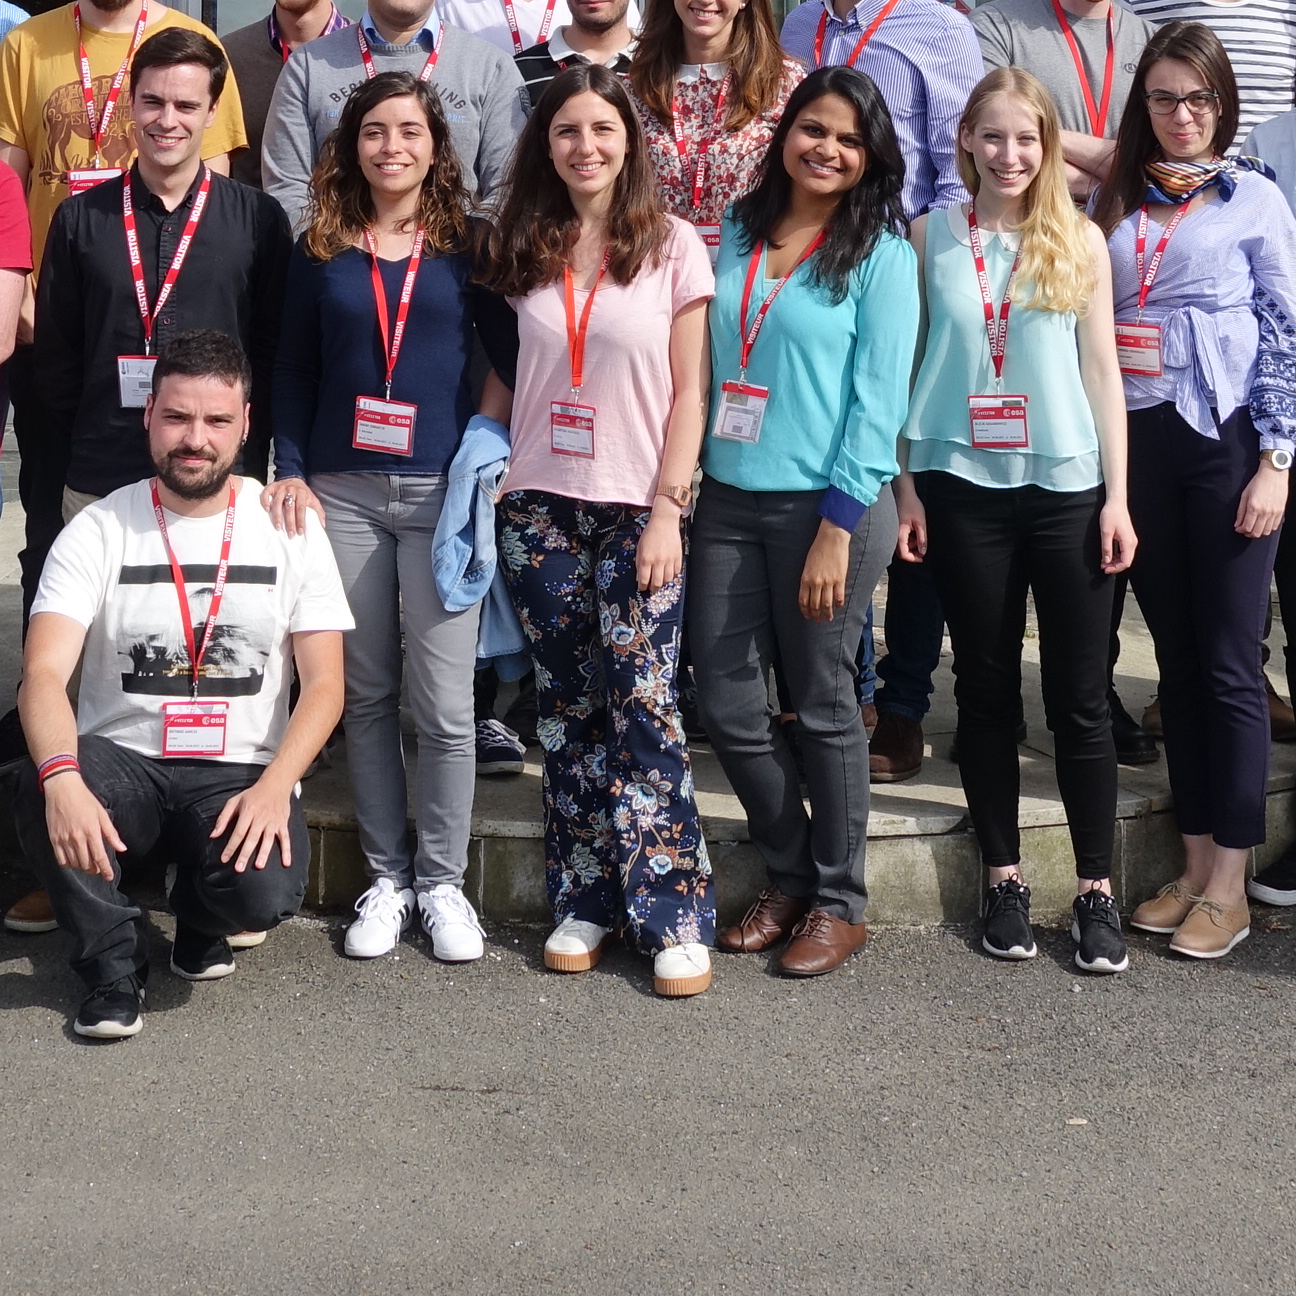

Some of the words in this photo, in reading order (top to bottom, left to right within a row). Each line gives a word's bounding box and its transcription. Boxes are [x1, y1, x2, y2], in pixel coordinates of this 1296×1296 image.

[506, 5, 517, 32] VISITOR
[540, 9, 553, 36] VISITOR
[81, 58, 91, 89] VISITOR
[113, 58, 129, 88] VISITOR
[86, 101, 96, 134] VISITOR
[100, 101, 115, 133] VISITOR
[696, 153, 705, 188] VISITOR
[123, 185, 132, 216] VISITOR
[190, 191, 207, 222] VISITOR
[970, 225, 982, 258] VISITOR
[1162, 211, 1184, 239] VISITOR
[127, 229, 140, 266] VISITOR
[171, 235, 191, 270] VISITOR
[412, 230, 424, 259] VISITEUR
[1144, 252, 1163, 286] VISITOR
[136, 279, 148, 317] VISITOR
[154, 284, 172, 317] VISITOR
[401, 271, 416, 303] VISITEUR
[765, 278, 787, 304] VISITEUR
[978, 271, 991, 304] VISITOR
[391, 321, 404, 357] VISITEUR
[747, 313, 764, 344] VISITEUR
[987, 319, 997, 357] VISITOR
[998, 319, 1007, 357] VISITOR
[224, 506, 235, 542] VISITEUR
[214, 559, 228, 597] VISITEUR
[201, 615, 216, 653] VISITEUR
